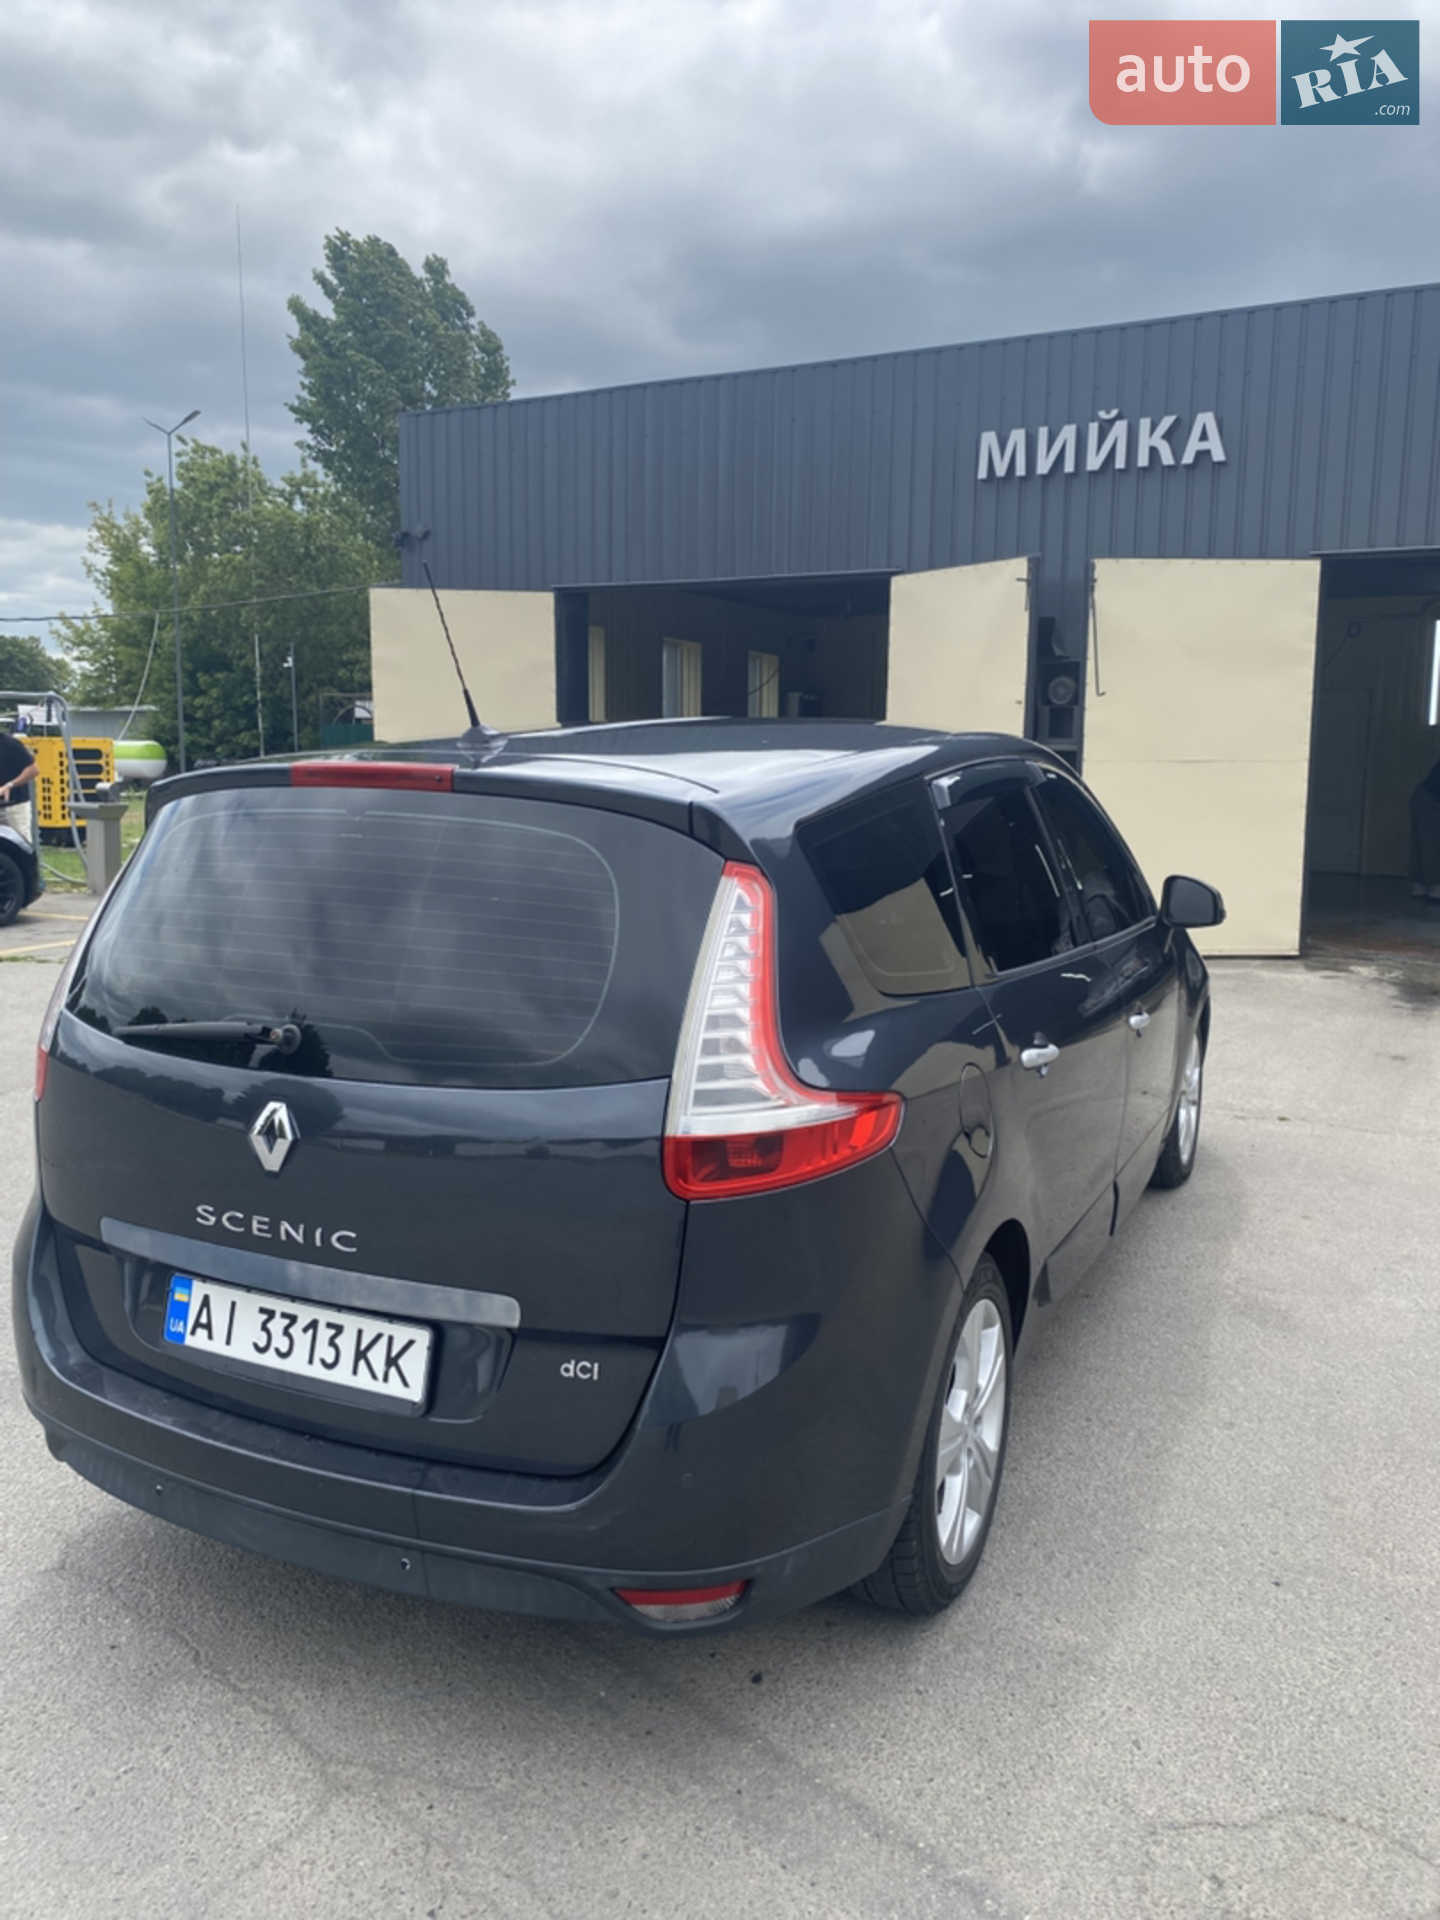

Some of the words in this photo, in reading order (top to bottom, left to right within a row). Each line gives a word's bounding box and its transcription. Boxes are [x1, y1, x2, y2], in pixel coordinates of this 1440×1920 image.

[977, 408, 1226, 480] МИЙКА
[195, 1204, 358, 1253] SCENIC
[169, 1317, 185, 1334] UA
[190, 1293, 237, 1346] AI
[252, 1307, 345, 1371] 3313
[351, 1327, 417, 1389] KK
